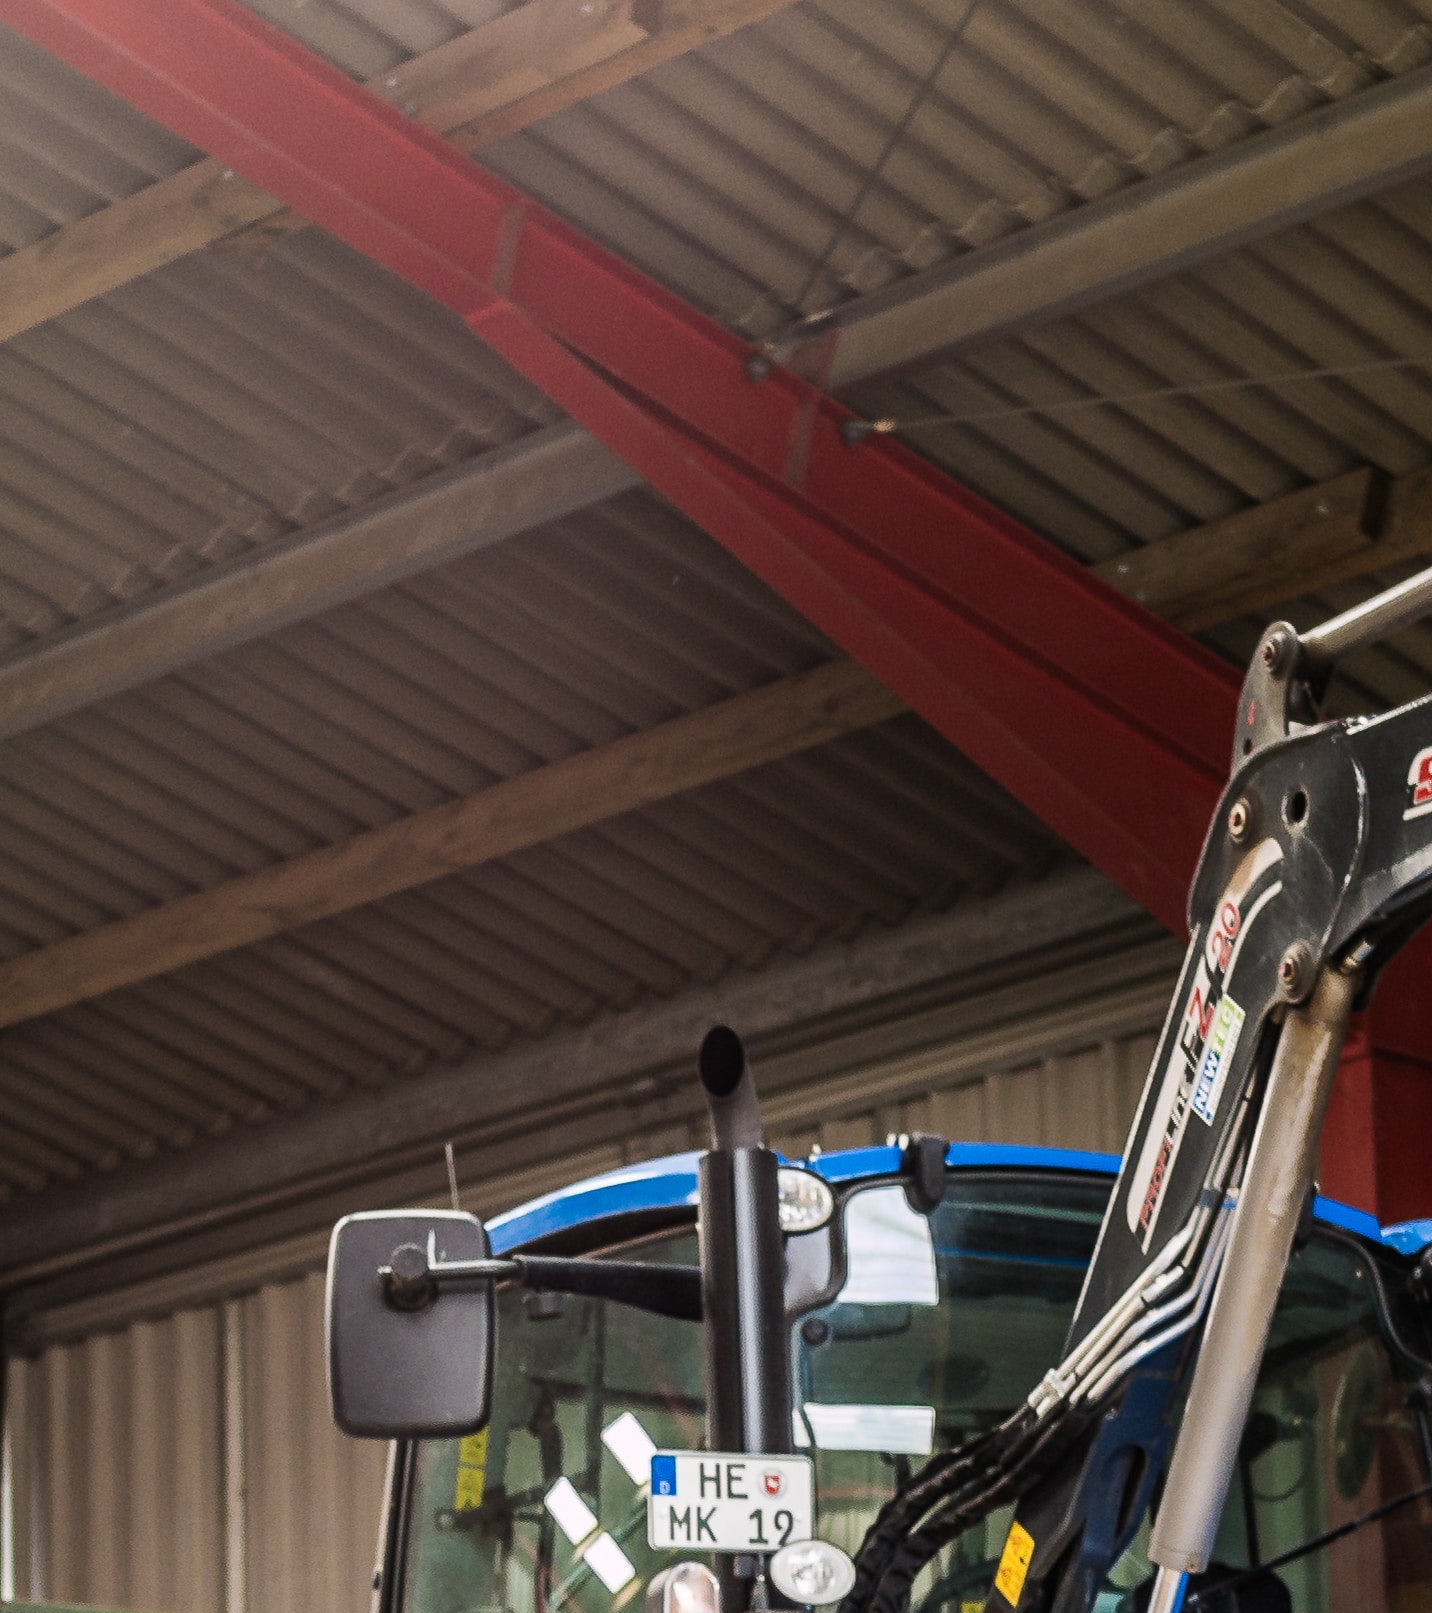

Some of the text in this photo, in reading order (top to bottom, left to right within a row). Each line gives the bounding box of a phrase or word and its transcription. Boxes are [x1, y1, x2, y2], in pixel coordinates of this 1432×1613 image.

[1211, 901, 1241, 973] 20
[700, 1462, 748, 1500] HE
[670, 1504, 794, 1546] MK 19
